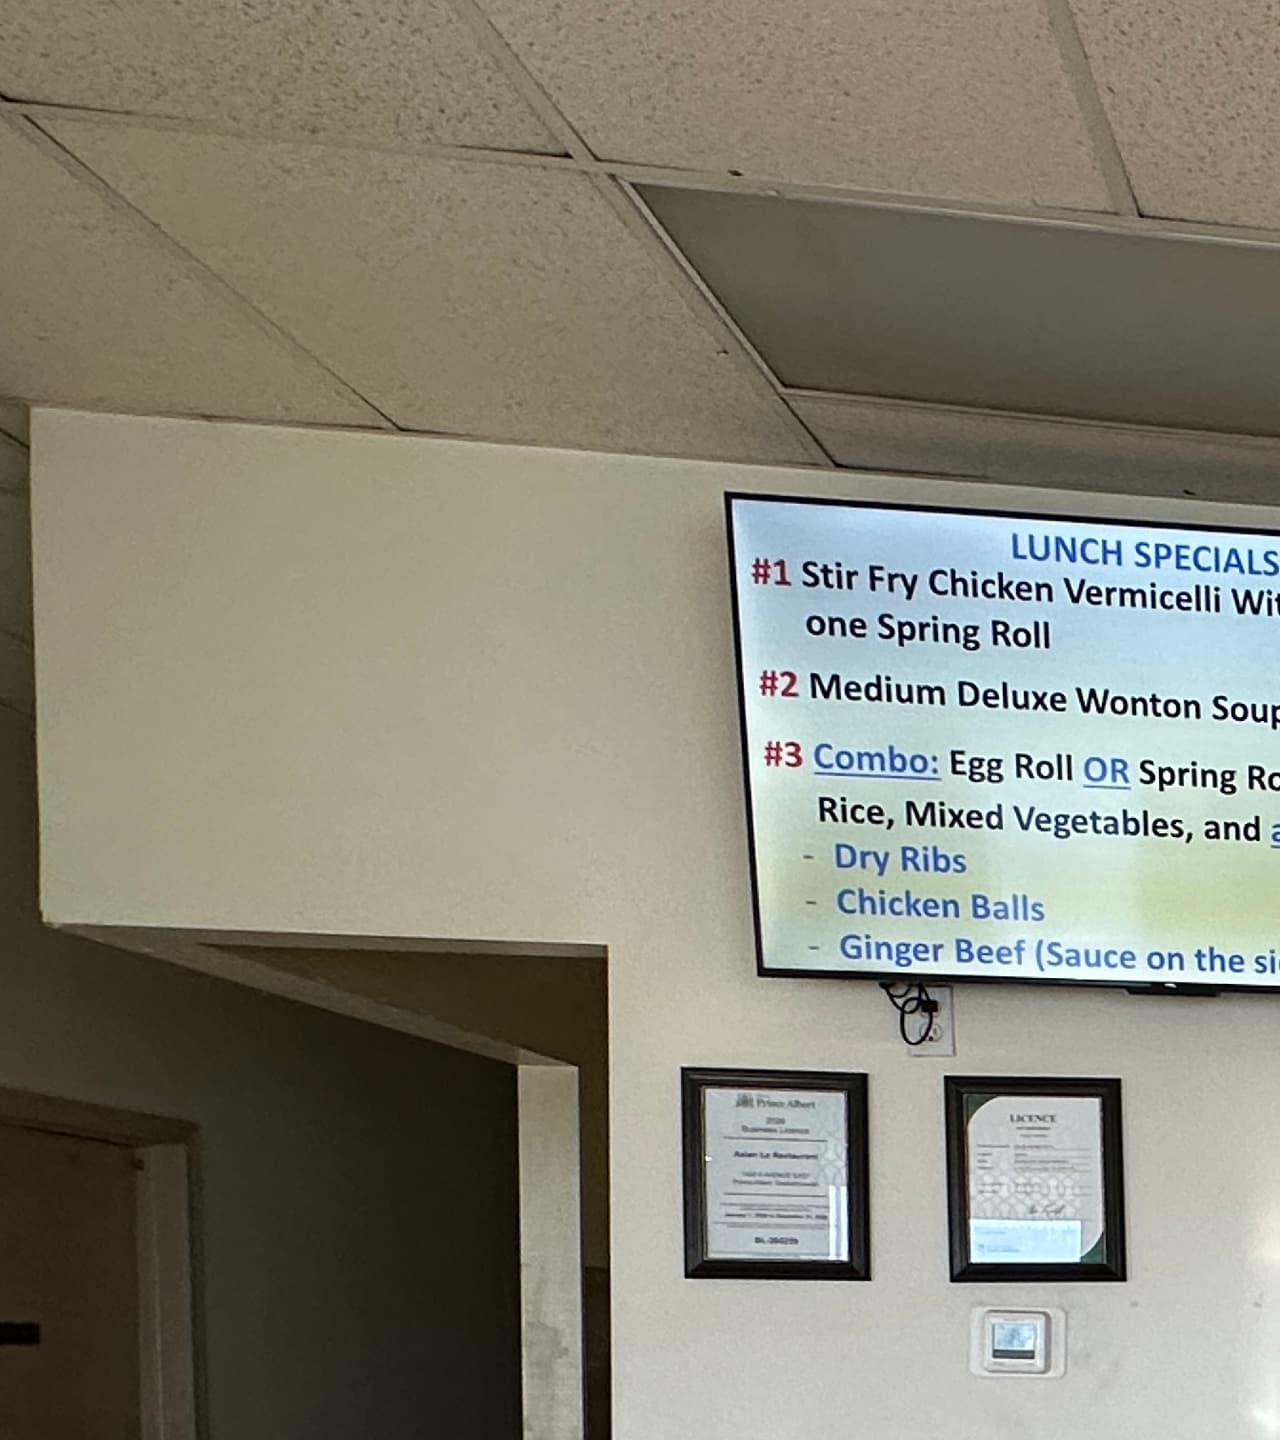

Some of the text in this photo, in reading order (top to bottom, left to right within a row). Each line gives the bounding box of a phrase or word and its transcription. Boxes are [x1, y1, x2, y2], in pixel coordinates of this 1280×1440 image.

[1011, 532, 1280, 577] LUNCH SPECIALS
[751, 558, 792, 586] #1
[801, 561, 859, 590] Stir
[868, 565, 918, 600] Fry
[929, 569, 1054, 602] Chicken
[1063, 577, 1221, 614] Vermicelli
[805, 614, 1051, 651] one Spring Roll
[759, 670, 799, 698] #2
[810, 672, 946, 706] Medium
[958, 681, 1067, 712] Deluxe
[1075, 687, 1201, 720] Wonton
[764, 741, 804, 768] #3
[814, 743, 940, 775] Combo:
[950, 750, 1005, 784] Egg
[1015, 753, 1073, 781] Roll
[1083, 757, 1130, 784] OR
[1139, 760, 1237, 795] Spring
[818, 797, 895, 830] Rice,
[906, 801, 1004, 830] Mixed
[1013, 806, 1194, 844] Vegetables,
[1204, 816, 1262, 842] and
[834, 843, 967, 877] Dry Ribs
[837, 888, 1045, 922] Chicken Balls
[840, 934, 944, 968] Ginger
[955, 939, 1027, 966] Beef
[1035, 939, 1137, 972] (Sauce
[1147, 952, 1185, 972] on
[1195, 947, 1245, 973] the
